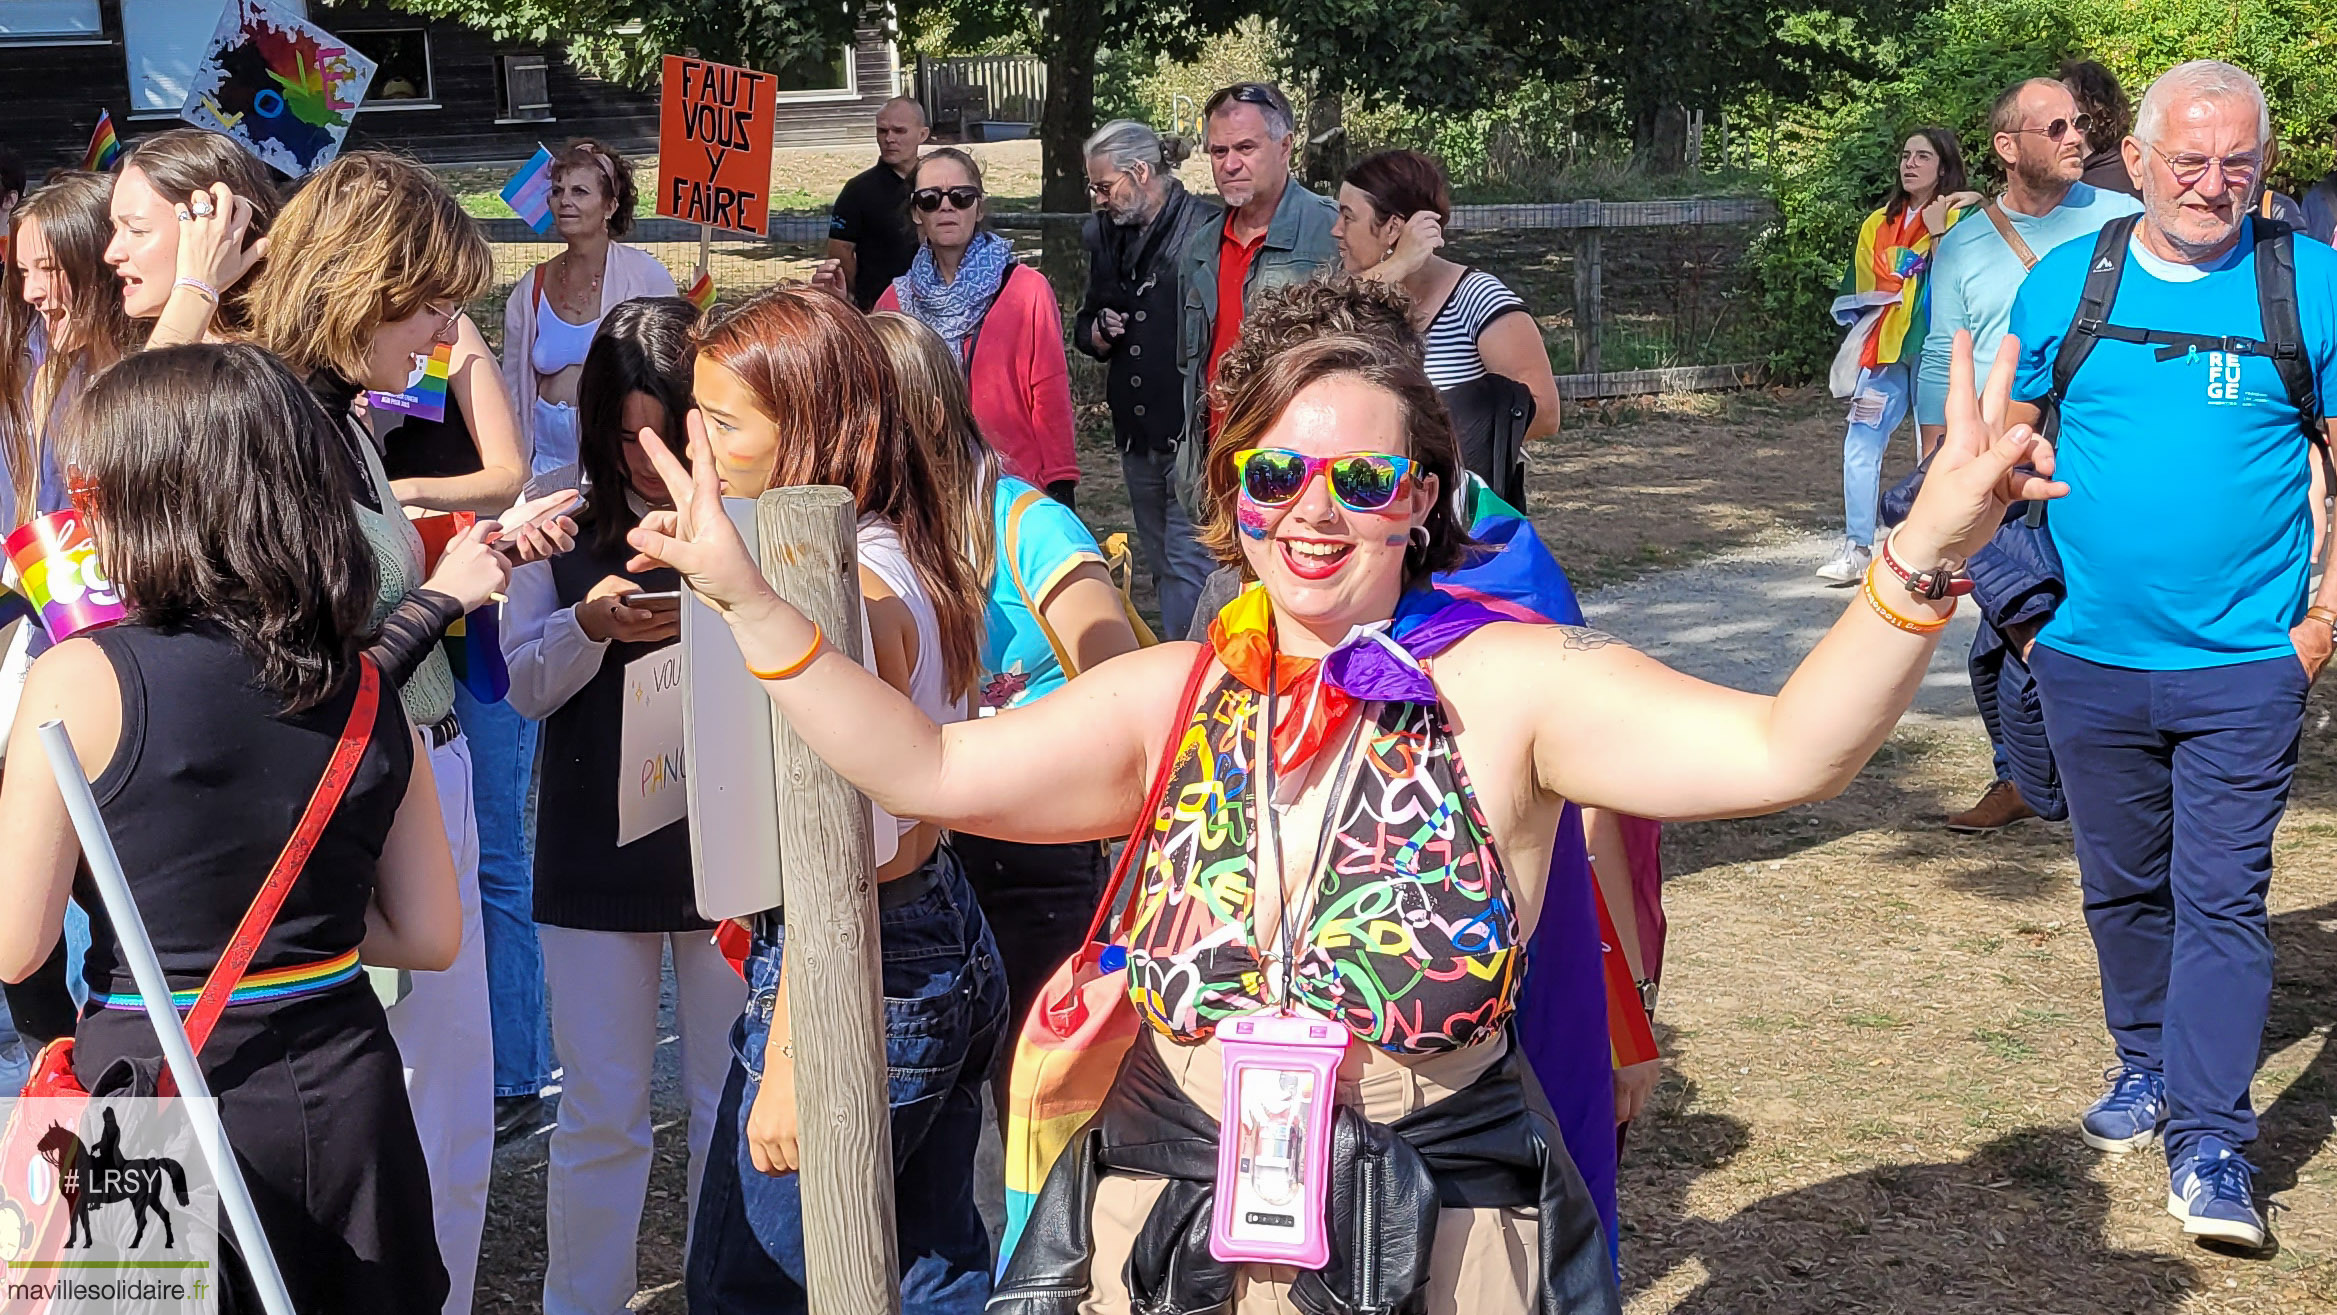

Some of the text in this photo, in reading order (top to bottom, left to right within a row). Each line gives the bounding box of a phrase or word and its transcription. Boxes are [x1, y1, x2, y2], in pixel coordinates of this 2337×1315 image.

[682, 61, 765, 112] FAUT
[682, 99, 754, 153] VOUS
[705, 146, 727, 184] Y
[2208, 382, 2240, 399] GE
[2209, 366, 2240, 383] FU
